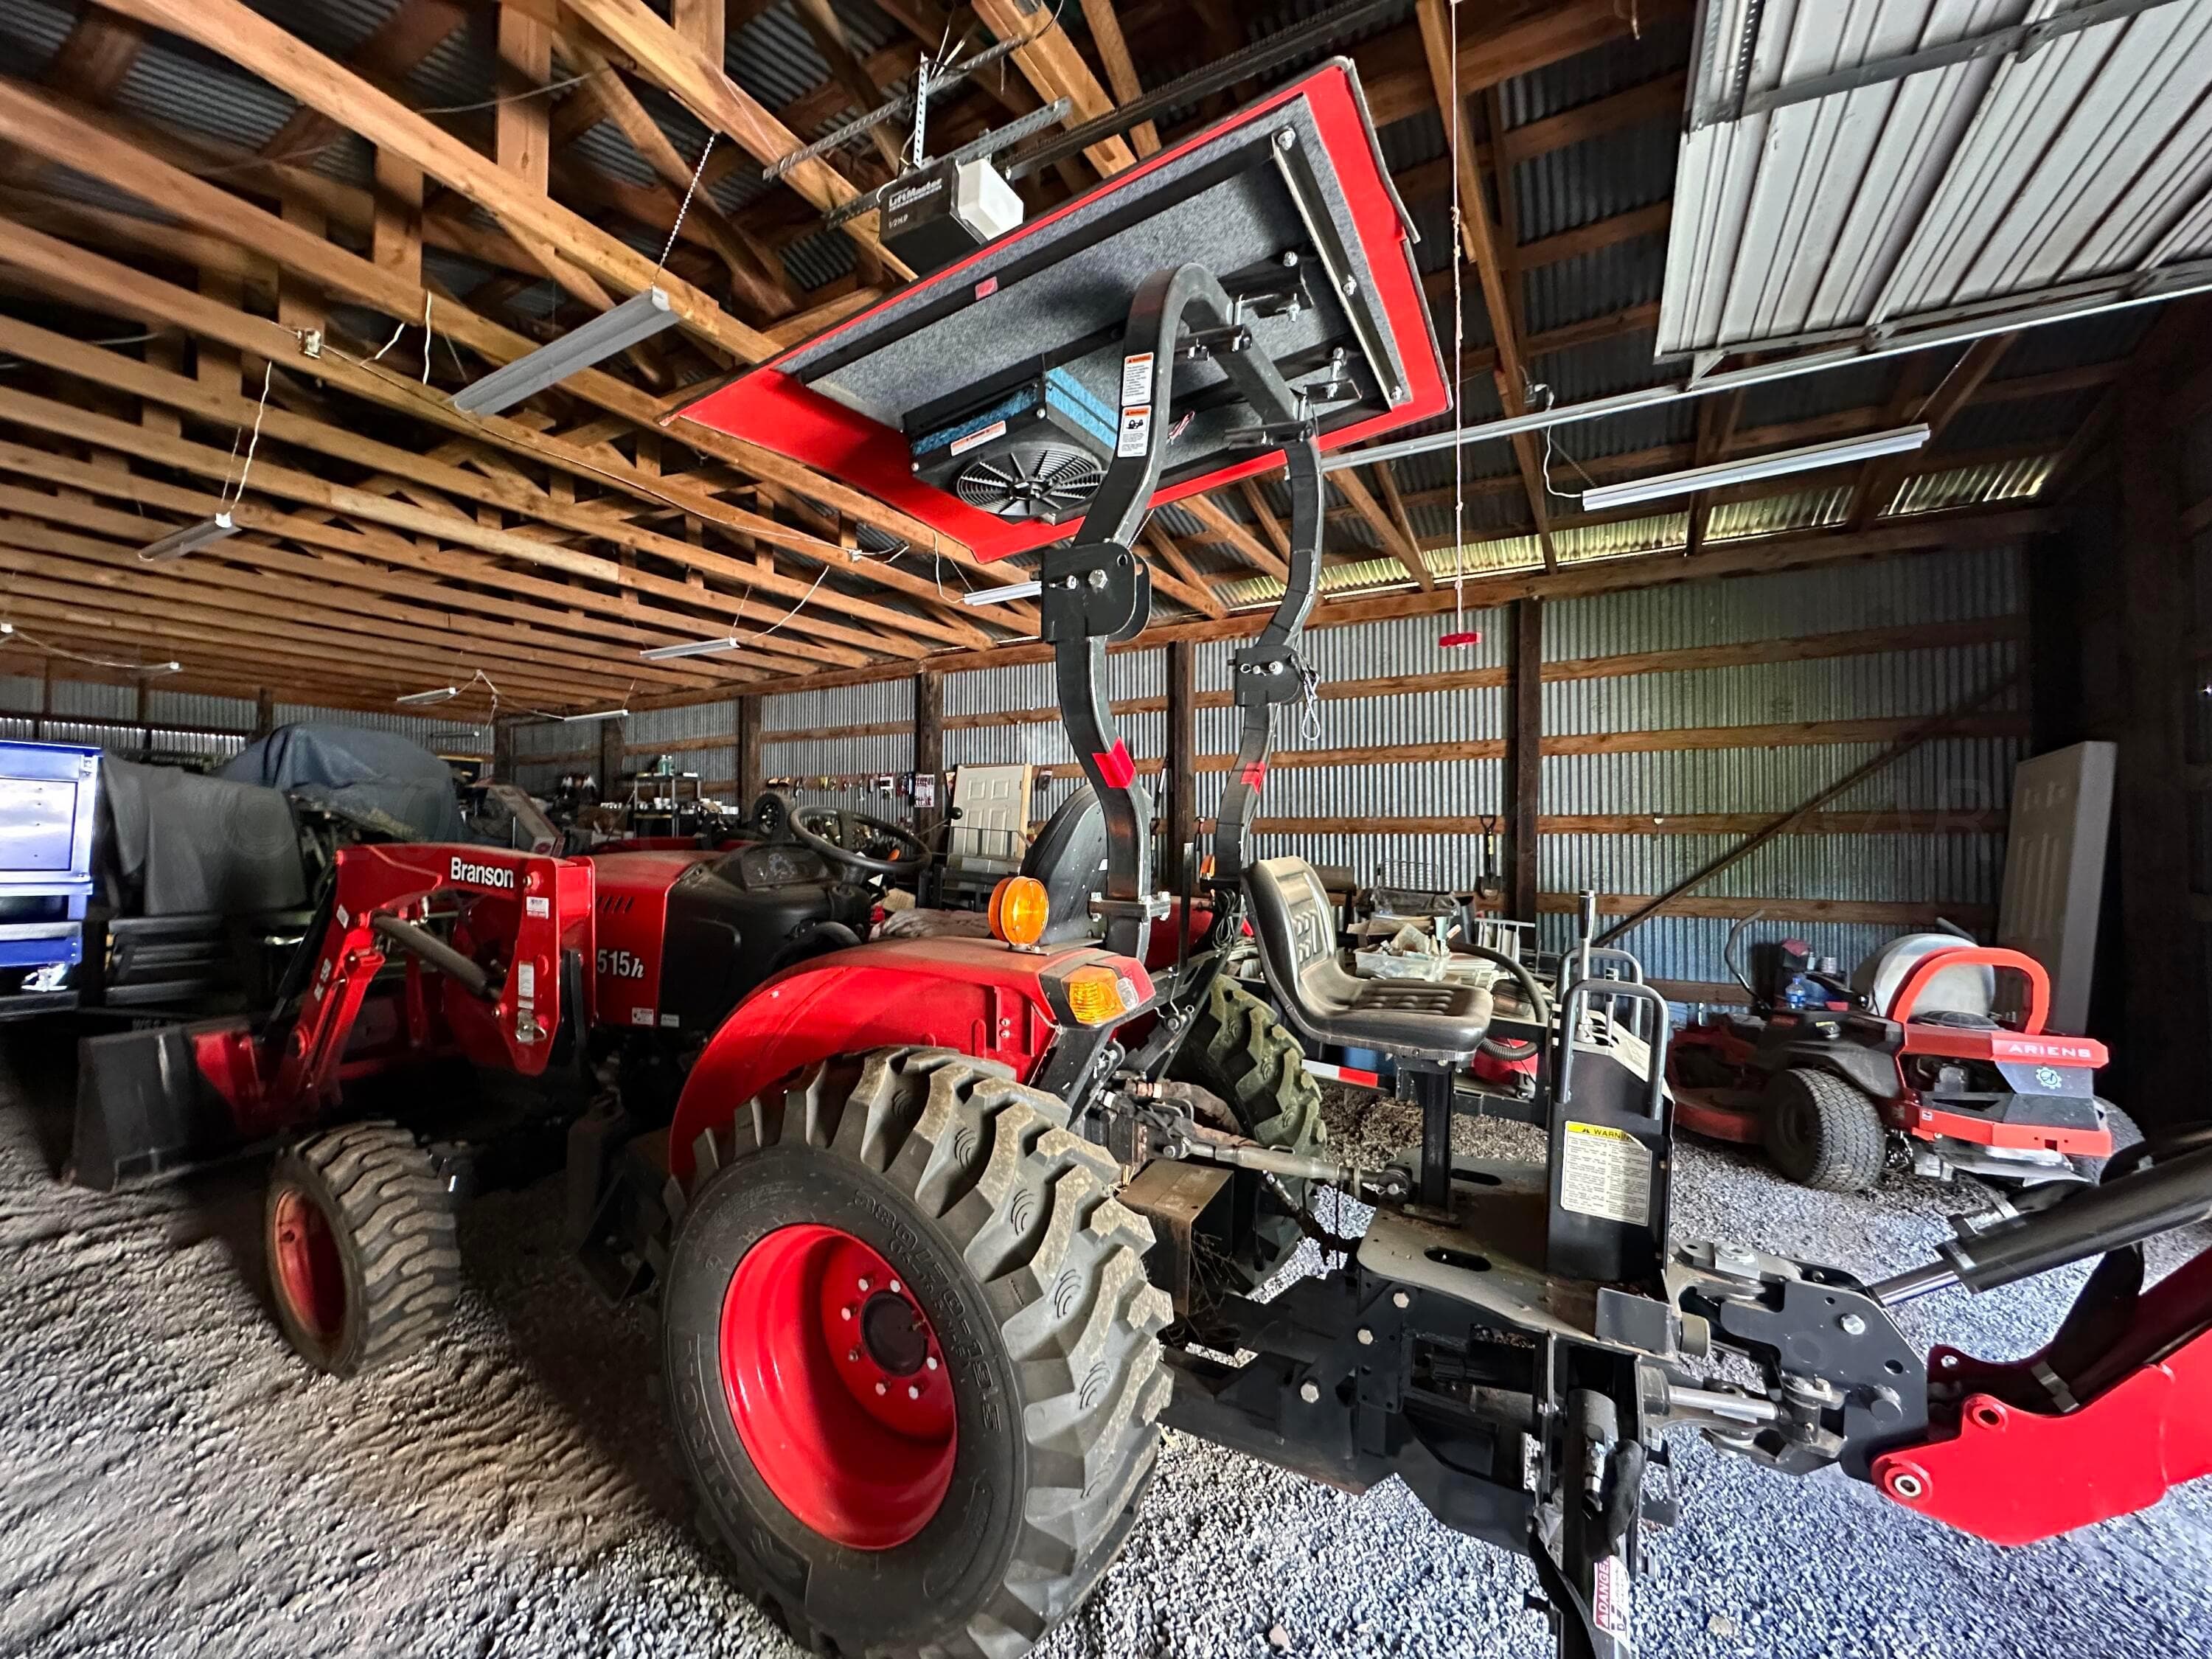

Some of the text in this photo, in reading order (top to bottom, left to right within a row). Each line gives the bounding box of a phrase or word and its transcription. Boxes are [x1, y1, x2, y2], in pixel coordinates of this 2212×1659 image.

[451, 856, 514, 888] Branson
[2008, 1043, 2091, 1059] ARIENS
[1593, 1128, 1634, 1142] WARNIN
